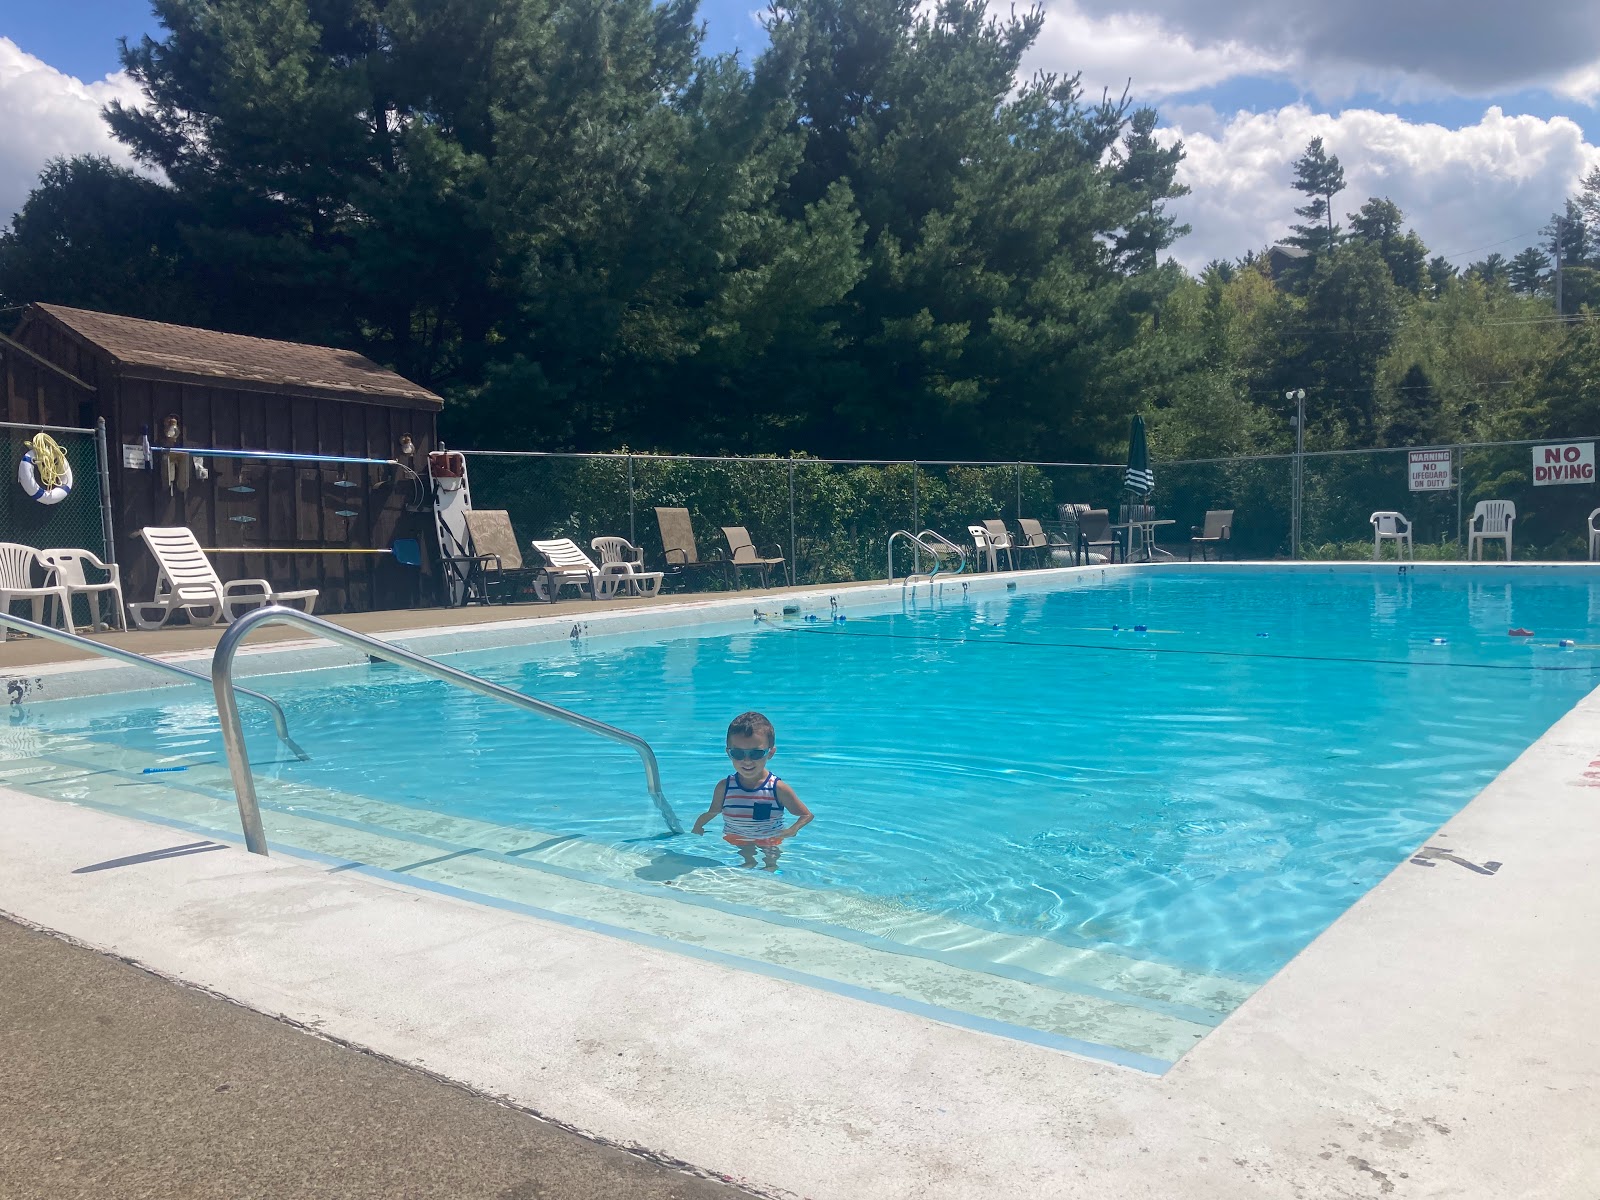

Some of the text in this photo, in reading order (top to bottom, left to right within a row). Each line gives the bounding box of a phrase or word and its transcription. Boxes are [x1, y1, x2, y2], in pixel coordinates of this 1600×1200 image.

[1410, 452, 1450, 462] WARNING
[1545, 446, 1581, 463] NO
[1422, 463, 1437, 471] NO
[1535, 463, 1593, 481] DIVING
[1412, 470, 1448, 480] LIFEGUARD
[1414, 479, 1446, 488] ON DUTY
